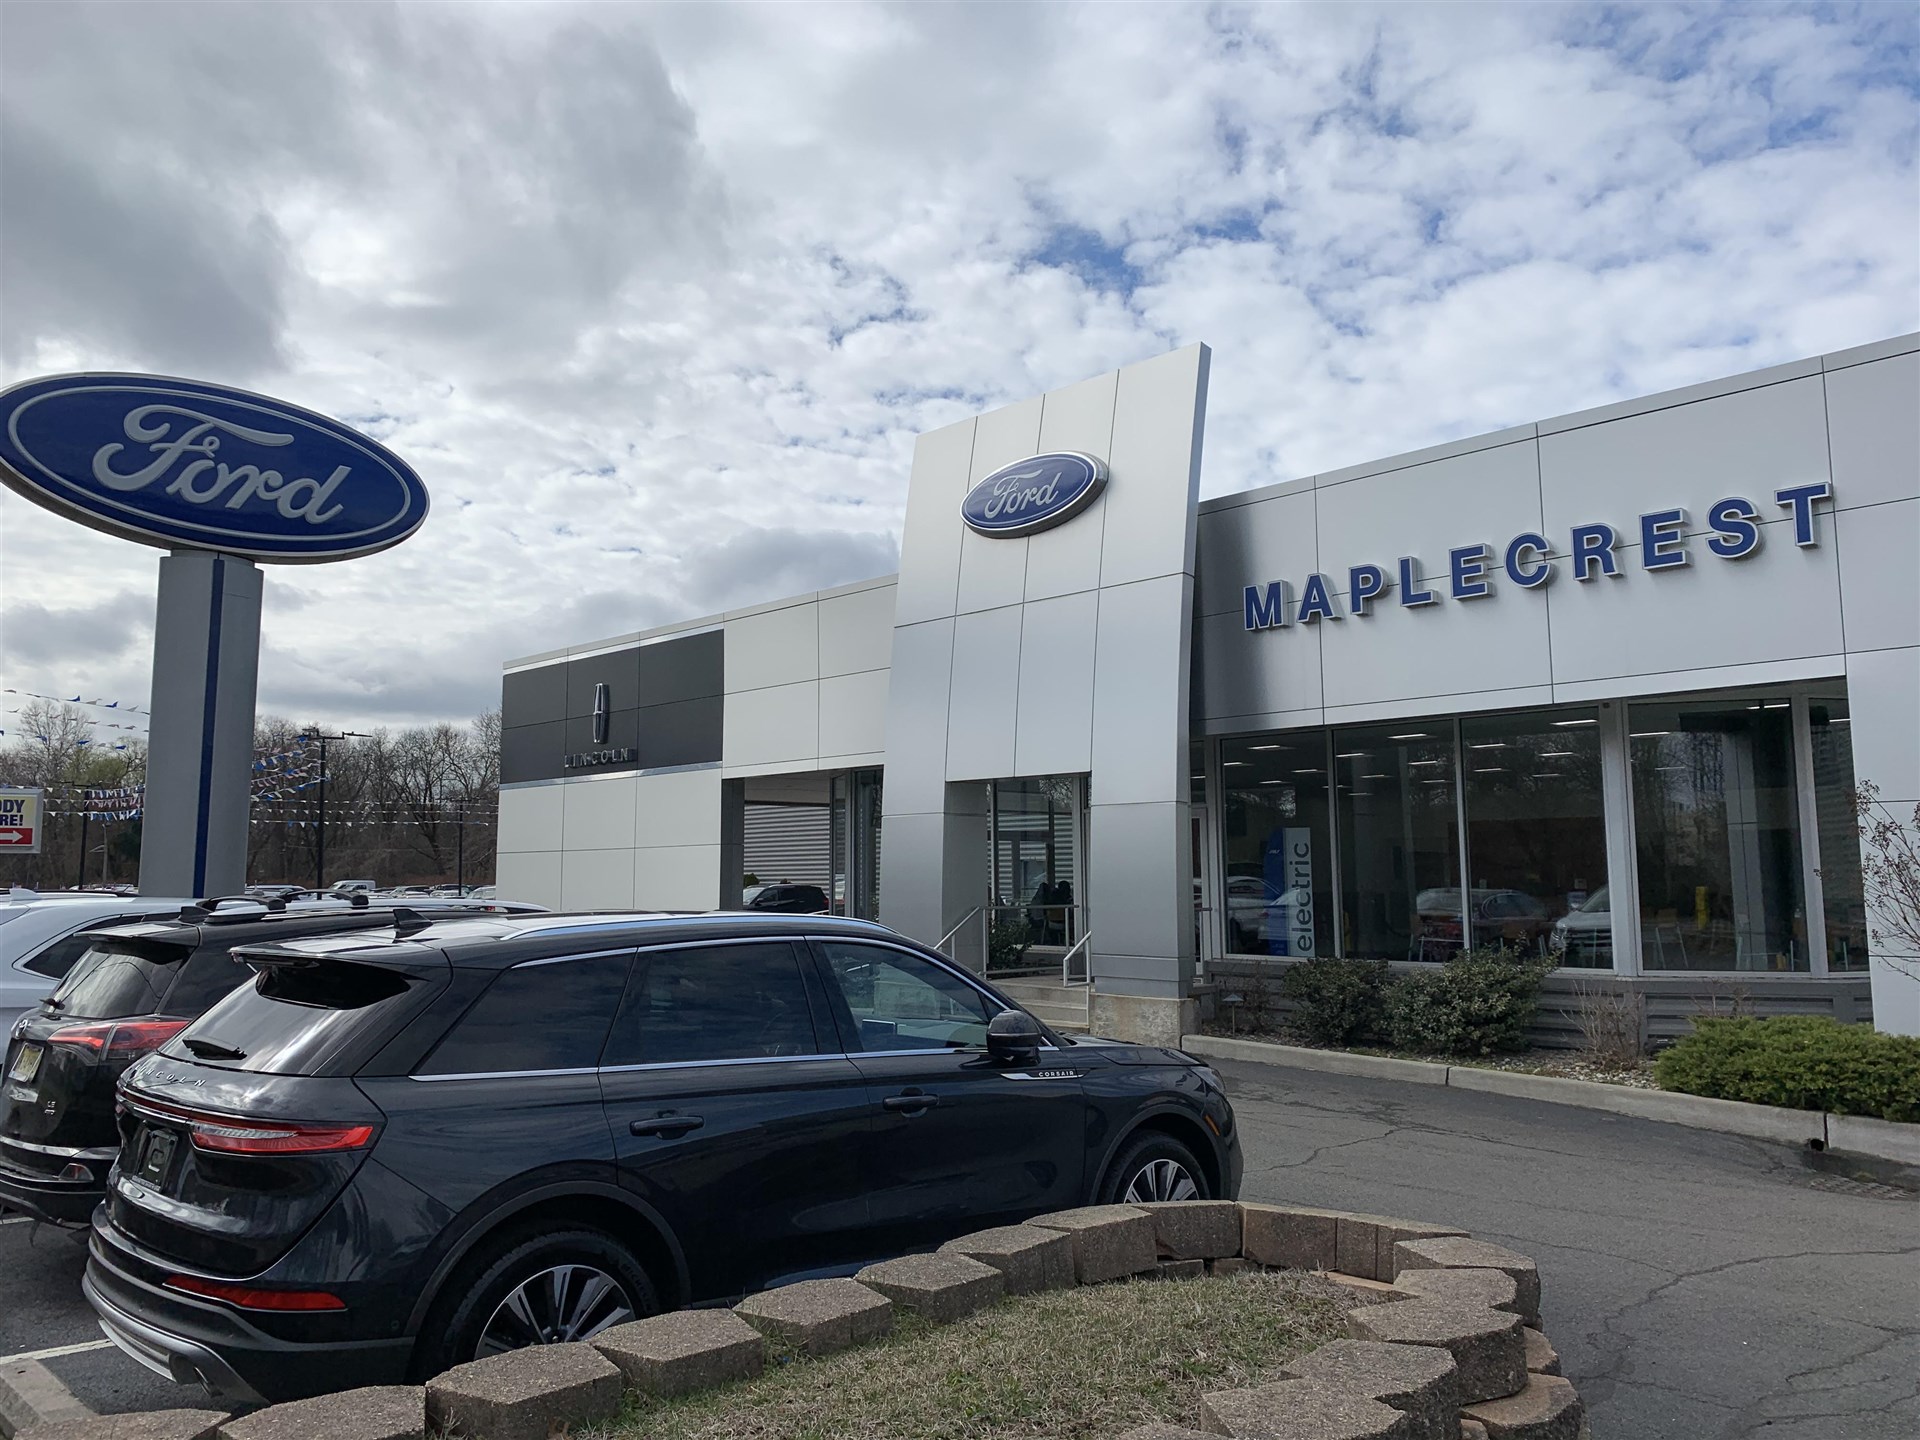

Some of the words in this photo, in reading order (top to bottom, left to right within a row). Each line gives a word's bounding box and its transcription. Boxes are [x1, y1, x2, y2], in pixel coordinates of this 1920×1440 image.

[92, 404, 352, 524] Ford
[984, 469, 1062, 519] Ford
[1243, 482, 1832, 632] MAPLECREST
[564, 747, 629, 768] LINCOLN
[0, 799, 26, 813] DY
[1289, 842, 1313, 952] electric
[134, 1065, 206, 1087] LINCOLN
[1038, 1070, 1075, 1078] CORSAIR
